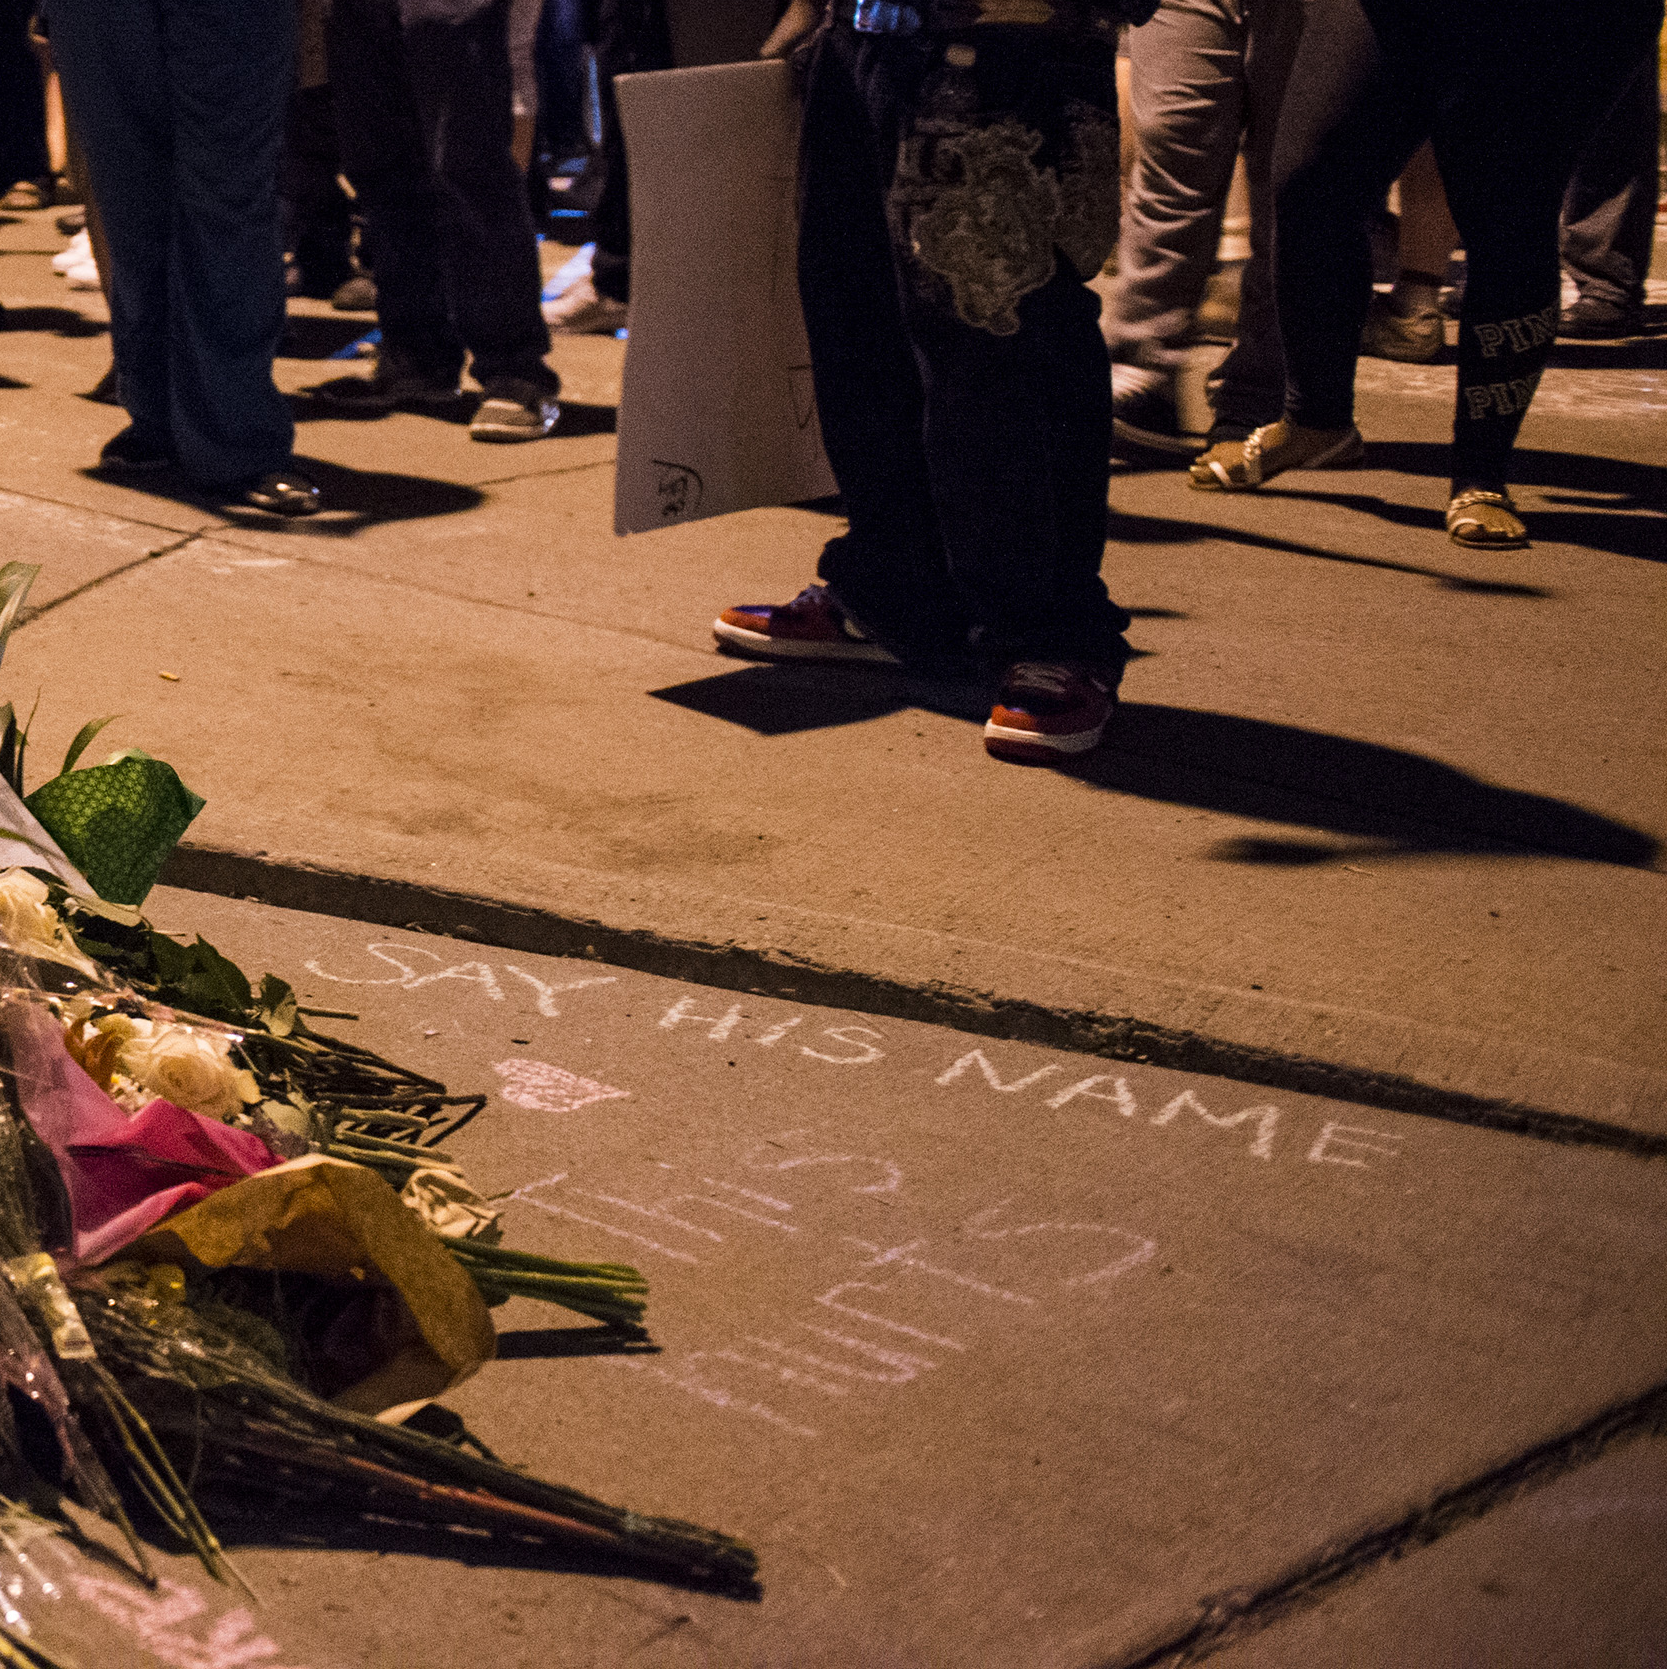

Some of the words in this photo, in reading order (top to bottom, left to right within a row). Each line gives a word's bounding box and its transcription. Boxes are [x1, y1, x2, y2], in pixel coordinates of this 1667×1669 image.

[303, 942, 619, 1019] SAY
[656, 993, 887, 1066] HIS
[932, 1045, 1407, 1172] NAME
